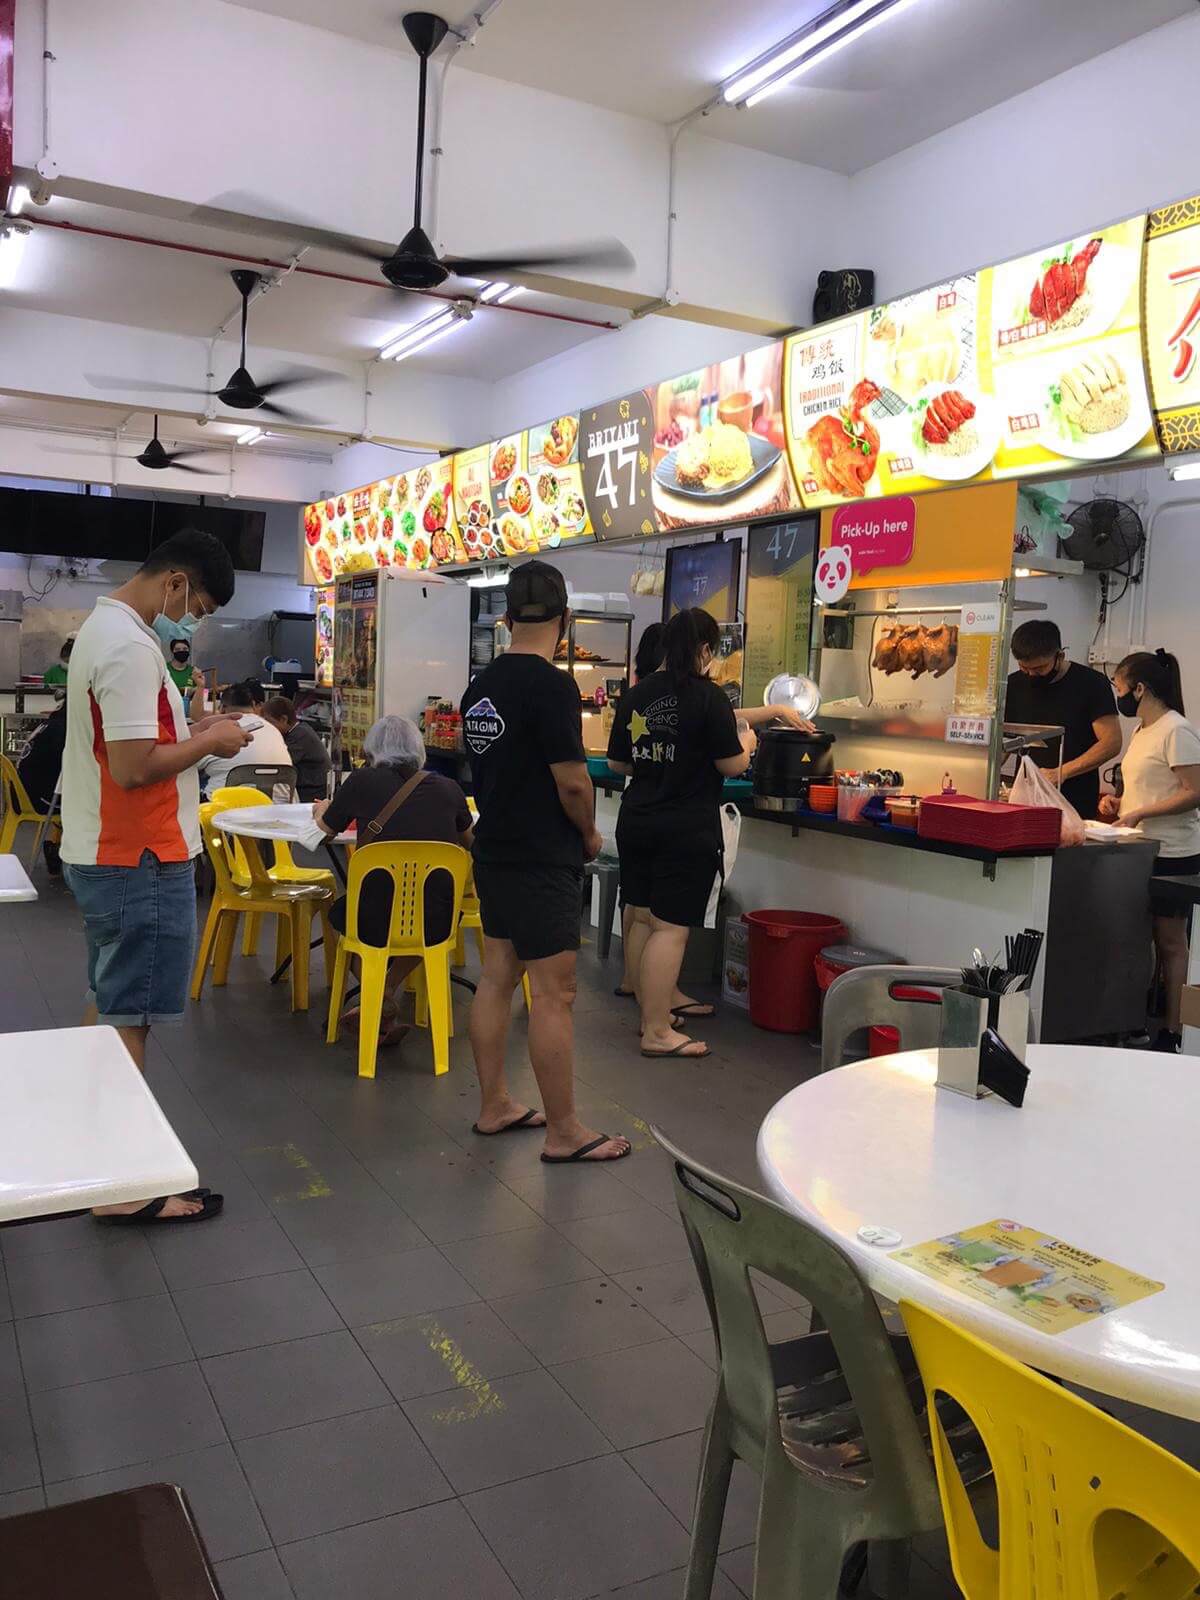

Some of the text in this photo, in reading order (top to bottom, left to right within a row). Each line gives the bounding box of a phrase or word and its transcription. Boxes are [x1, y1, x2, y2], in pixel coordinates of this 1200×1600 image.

[595, 447, 638, 509] 47
[841, 519, 908, 539] Pick-Up here
[766, 524, 798, 559] 47
[976, 614, 995, 622] CLEAN
[645, 696, 678, 716] CHUNG
[647, 714, 679, 726] CHENG
[949, 730, 985, 741] SELF-SERVICE
[1051, 1241, 1102, 1265] LOWER
